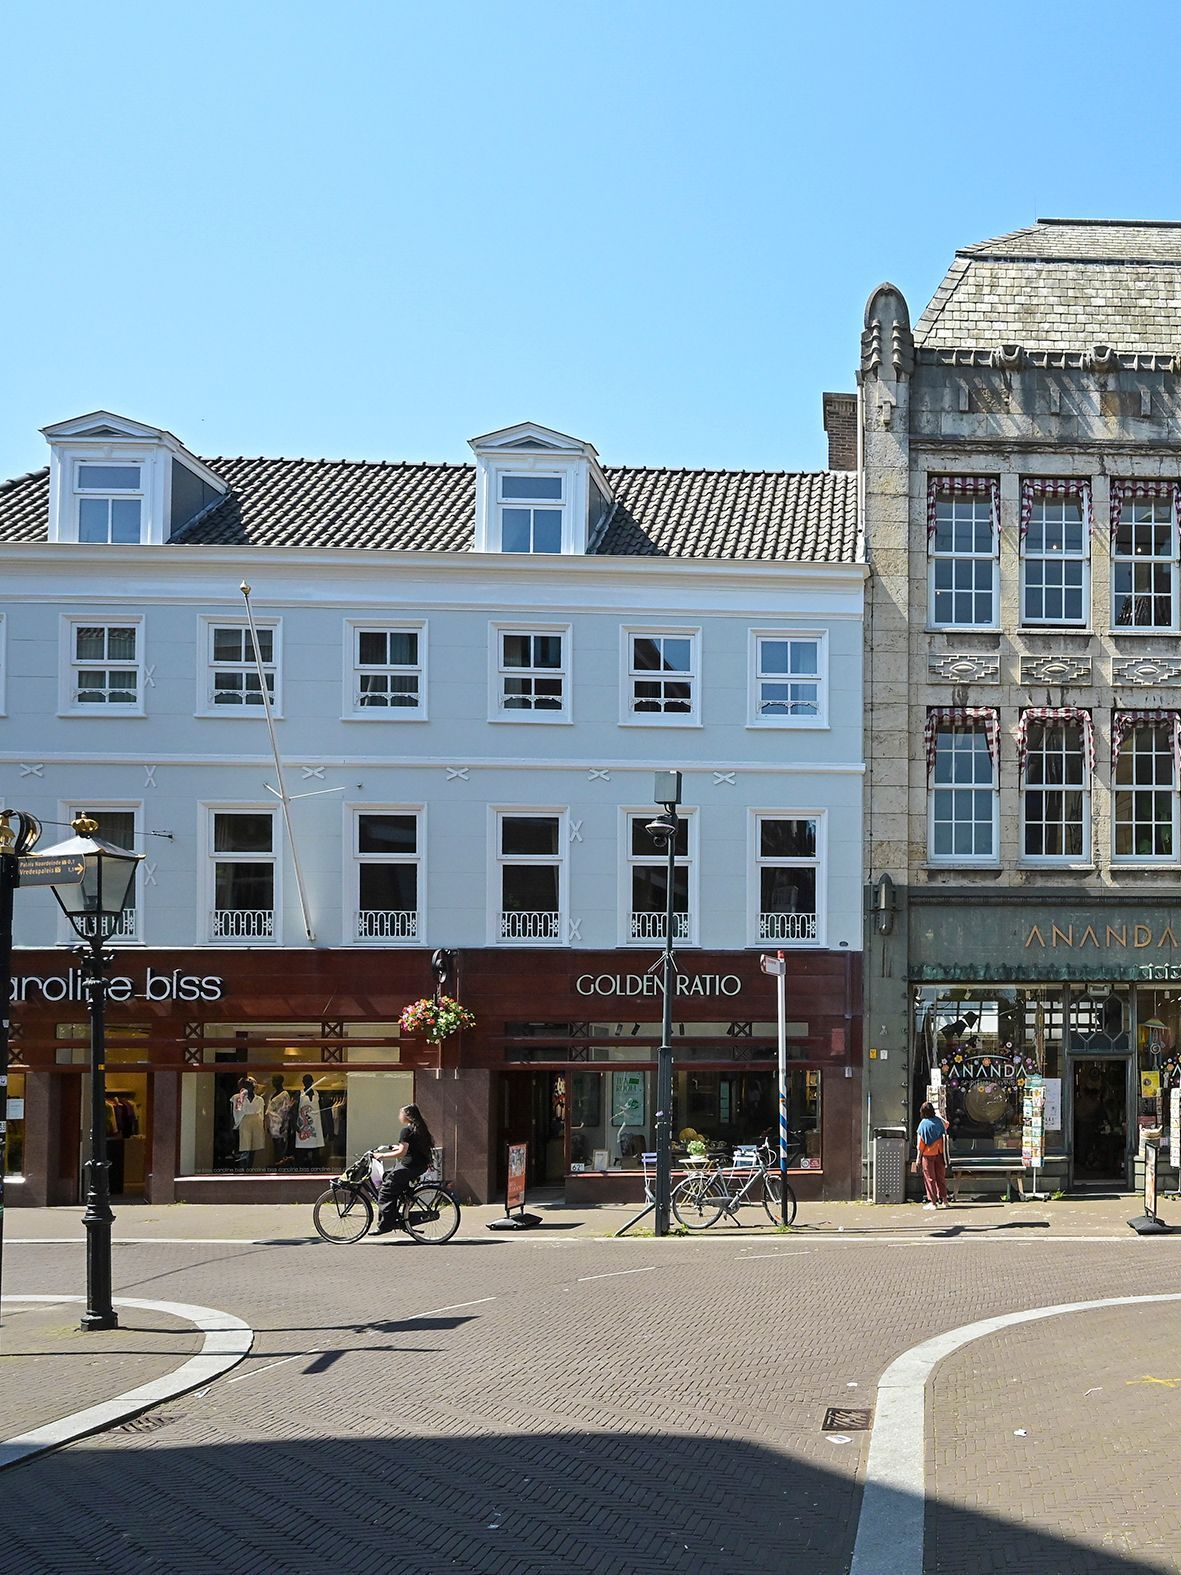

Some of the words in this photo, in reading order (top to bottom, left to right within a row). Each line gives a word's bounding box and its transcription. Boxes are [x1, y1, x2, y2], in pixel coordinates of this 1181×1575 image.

[1025, 924, 1180, 948] ANANDA
[146, 967, 223, 1001] biss
[576, 974, 665, 996] GOLDEN
[676, 974, 742, 996] RATIO
[948, 1064, 1027, 1078] ANANDA
